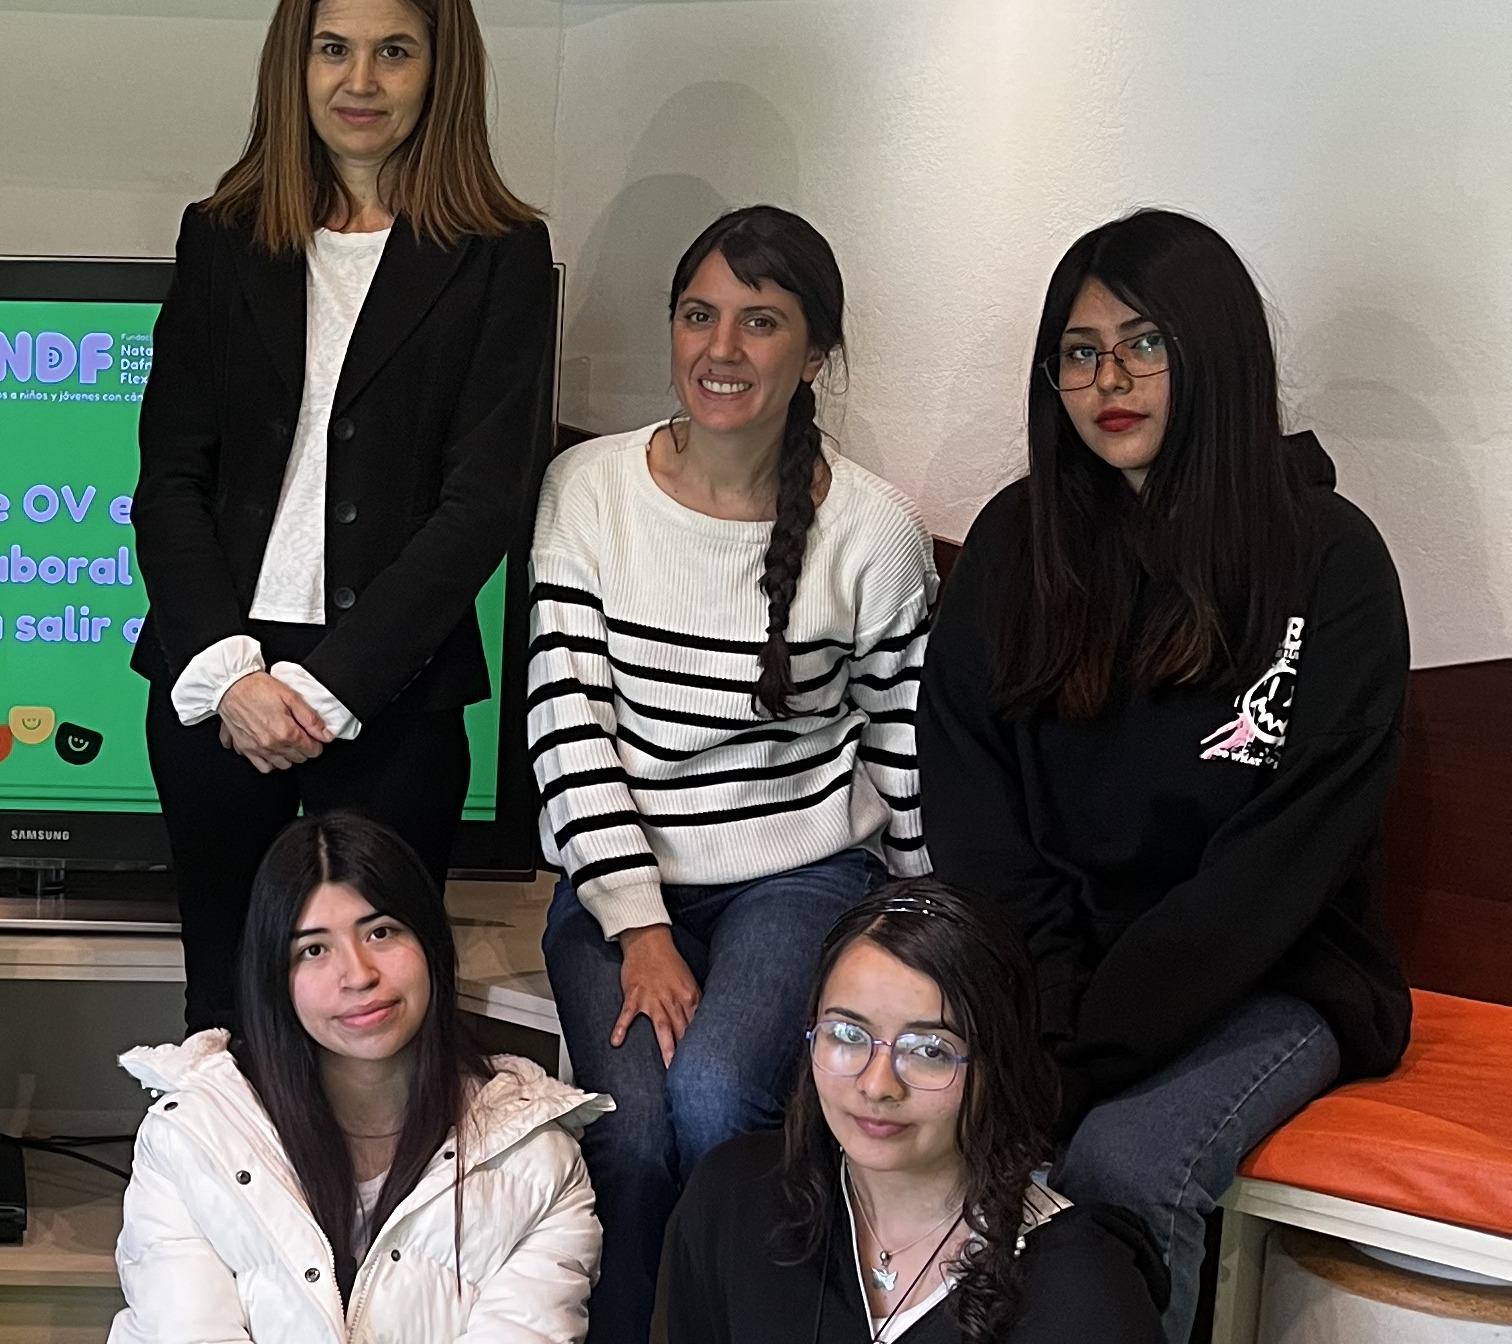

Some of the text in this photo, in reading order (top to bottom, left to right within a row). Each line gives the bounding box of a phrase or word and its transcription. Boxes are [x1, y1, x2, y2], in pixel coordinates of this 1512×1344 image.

[120, 372, 149, 385] Flex
[10, 392, 18, 400] a
[19, 390, 48, 401] niños
[50, 393, 58, 402] y
[58, 390, 100, 403] jóvenes
[102, 393, 122, 402] con
[22, 484, 97, 523] OV
[14, 605, 111, 643] salir
[10, 829, 70, 841] SAMSUNG
